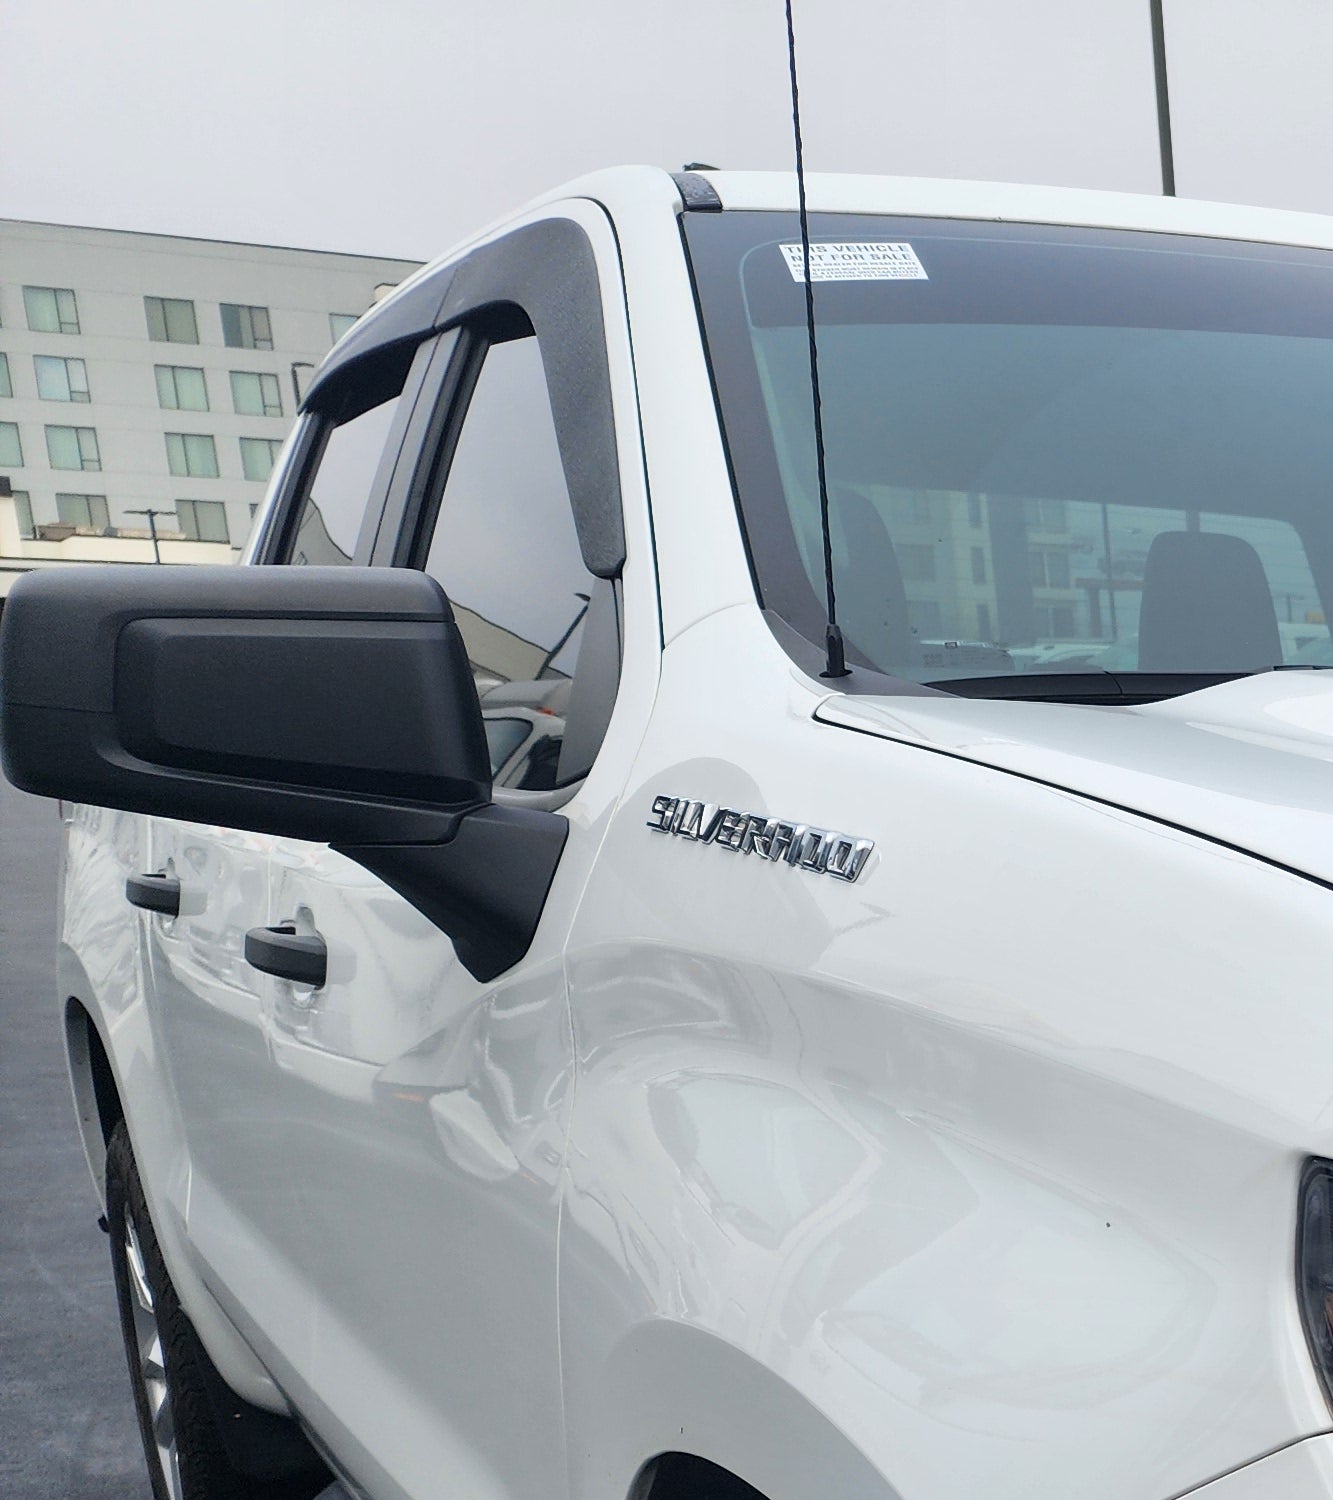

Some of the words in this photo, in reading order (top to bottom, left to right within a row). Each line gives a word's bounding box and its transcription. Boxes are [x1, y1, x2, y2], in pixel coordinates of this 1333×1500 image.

[833, 244, 907, 252] VEHICLE
[831, 253, 865, 261] FOR
[870, 253, 912, 261] SALE
[646, 795, 876, 883] SILVERADO
